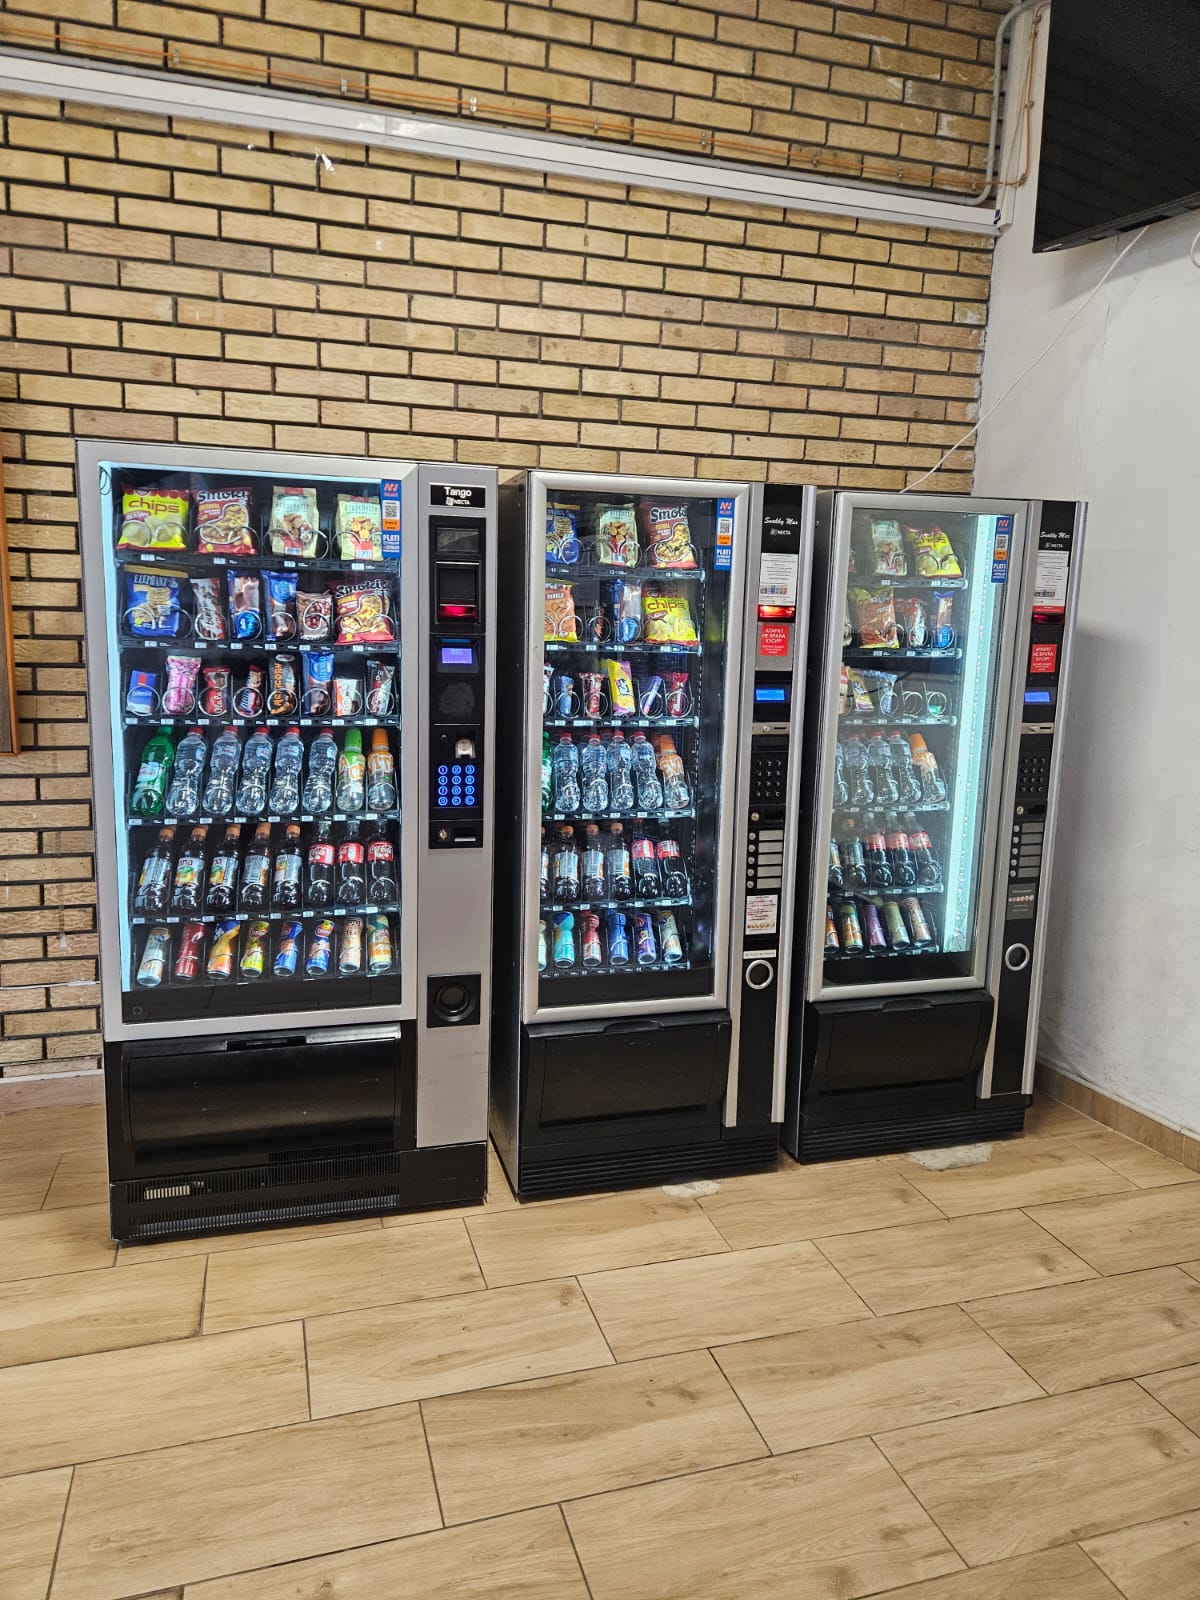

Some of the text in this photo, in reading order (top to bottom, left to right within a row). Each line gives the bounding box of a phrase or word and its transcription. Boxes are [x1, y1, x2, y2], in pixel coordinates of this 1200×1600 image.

[197, 490, 247, 504] Smoki
[443, 486, 472, 499] Tango
[128, 498, 179, 515] chips
[335, 579, 382, 598] Smoki
[647, 599, 686, 612] chips
